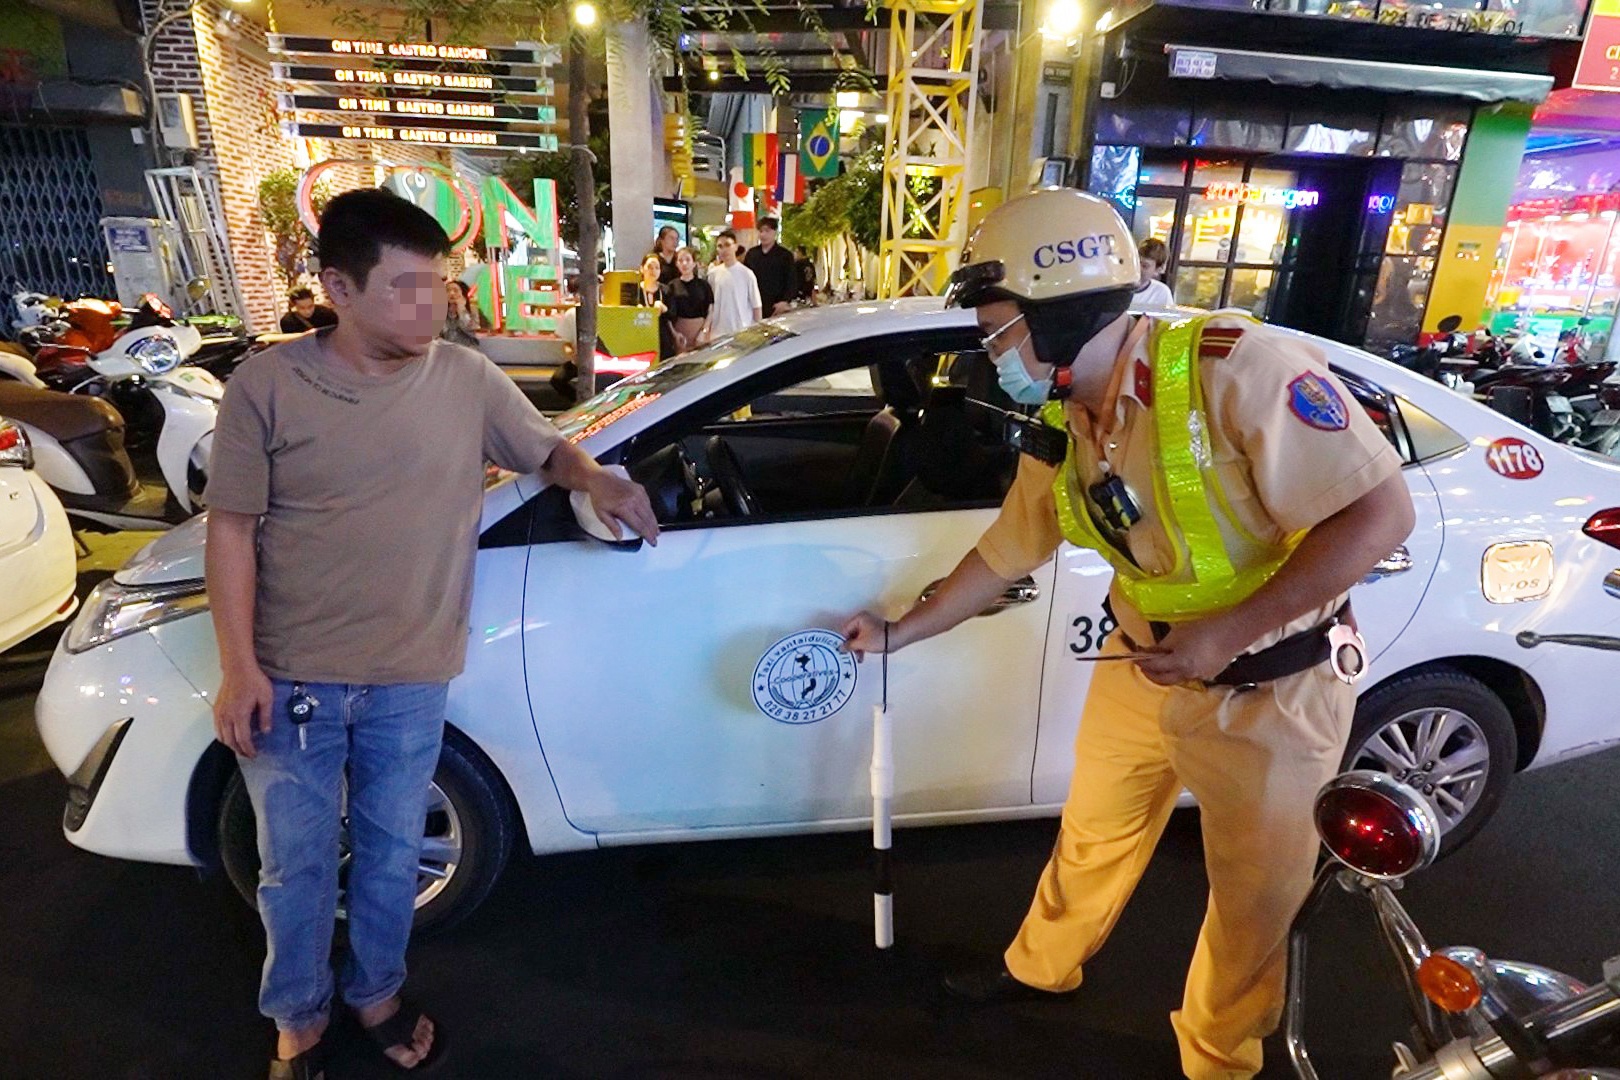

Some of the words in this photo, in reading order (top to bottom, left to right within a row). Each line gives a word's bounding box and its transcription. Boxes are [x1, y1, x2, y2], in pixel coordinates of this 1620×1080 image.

[331, 40, 351, 53] ON
[352, 41, 384, 55] TIME
[388, 43, 437, 57] GASTRO
[438, 46, 488, 60] GARDEN
[334, 69, 354, 81] ON
[393, 72, 441, 86] GASTRO
[443, 75, 493, 89] GARDEN
[338, 98, 358, 110] ON
[360, 98, 391, 111] TIME
[396, 101, 444, 115] GASTRO
[446, 103, 495, 117] GARDEN
[342, 126, 361, 138] ON
[363, 127, 394, 139] TIME
[399, 129, 447, 142] GASTRO
[449, 132, 497, 145] GARDEN
[1033, 234, 1115, 269] CSGT
[1490, 445, 1542, 474] 1178
[802, 710, 816, 720] 27
[820, 702, 833, 715] 27
